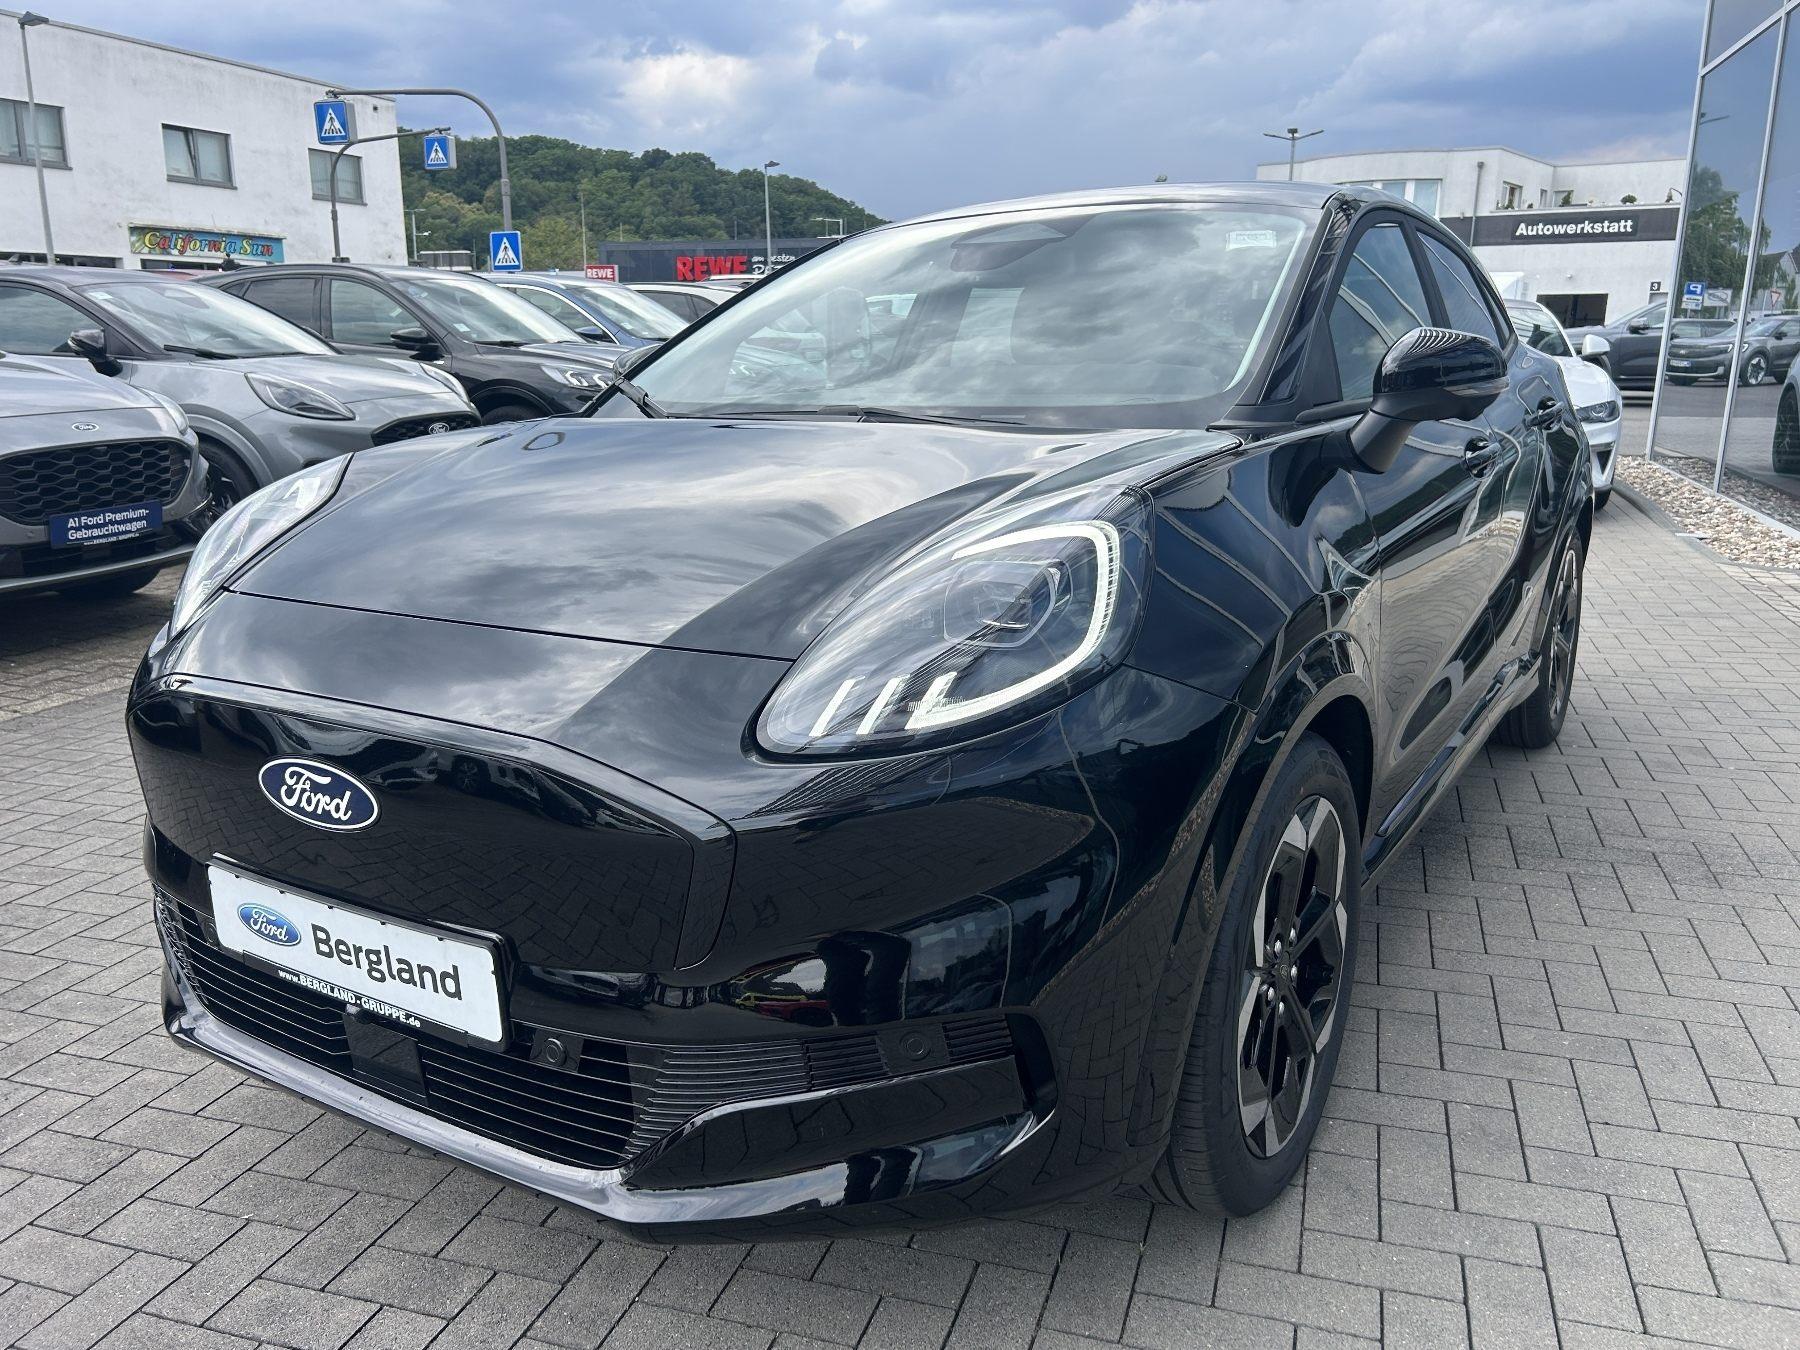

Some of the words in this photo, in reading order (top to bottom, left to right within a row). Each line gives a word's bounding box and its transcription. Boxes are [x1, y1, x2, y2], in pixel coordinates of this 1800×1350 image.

[1515, 219, 1633, 236] Autowerkstatt
[144, 231, 236, 255] California
[239, 237, 273, 257] Sun
[586, 268, 614, 279] REWE
[676, 255, 748, 281] REWE
[1652, 283, 1658, 291] 3
[67, 518, 79, 529] A1
[81, 514, 104, 526] Ford
[105, 508, 150, 523] Premium-
[68, 519, 147, 540] Gebrauchtwagen
[280, 766, 352, 821] Ford
[250, 910, 289, 942] Ford
[311, 923, 463, 1001] Bergland
